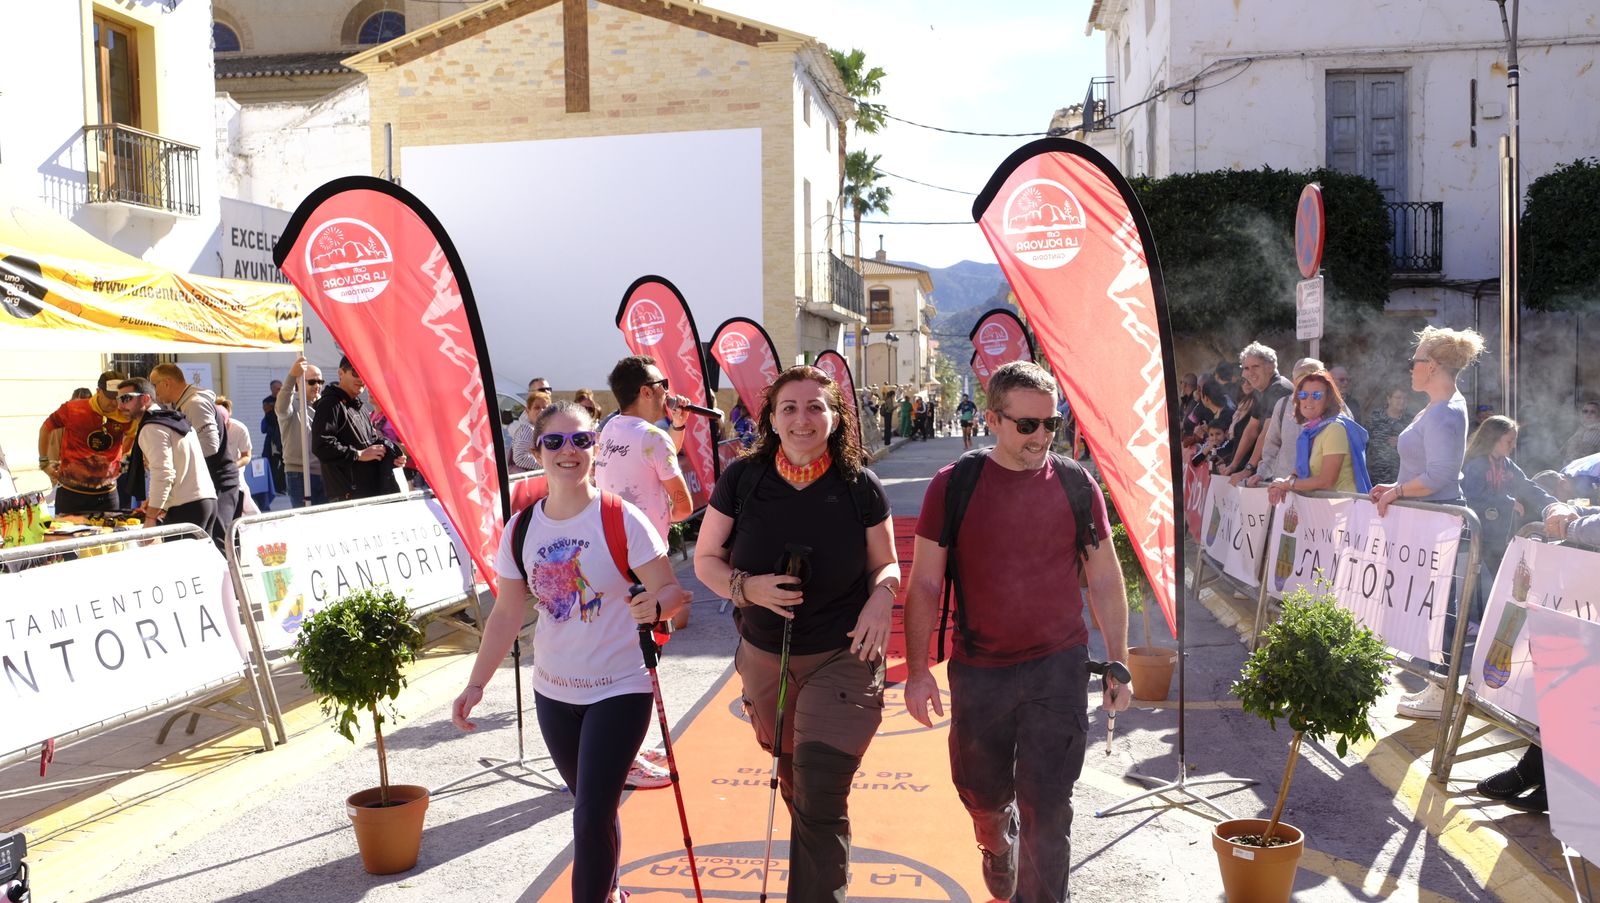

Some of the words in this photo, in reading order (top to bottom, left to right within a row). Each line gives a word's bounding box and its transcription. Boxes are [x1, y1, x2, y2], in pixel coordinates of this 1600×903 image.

[231, 227, 279, 252] EXCELE
[4, 274, 20, 282] uno
[307, 526, 428, 562] AYUNTAMENTO
[433, 522, 451, 536] DE
[310, 541, 462, 602] CANTORIA
[1417, 548, 1439, 571] DE
[6, 585, 164, 641] TAMIENTO
[175, 576, 204, 599] DE
[2, 604, 222, 698] NTORIA
[871, 872, 923, 888] LA
